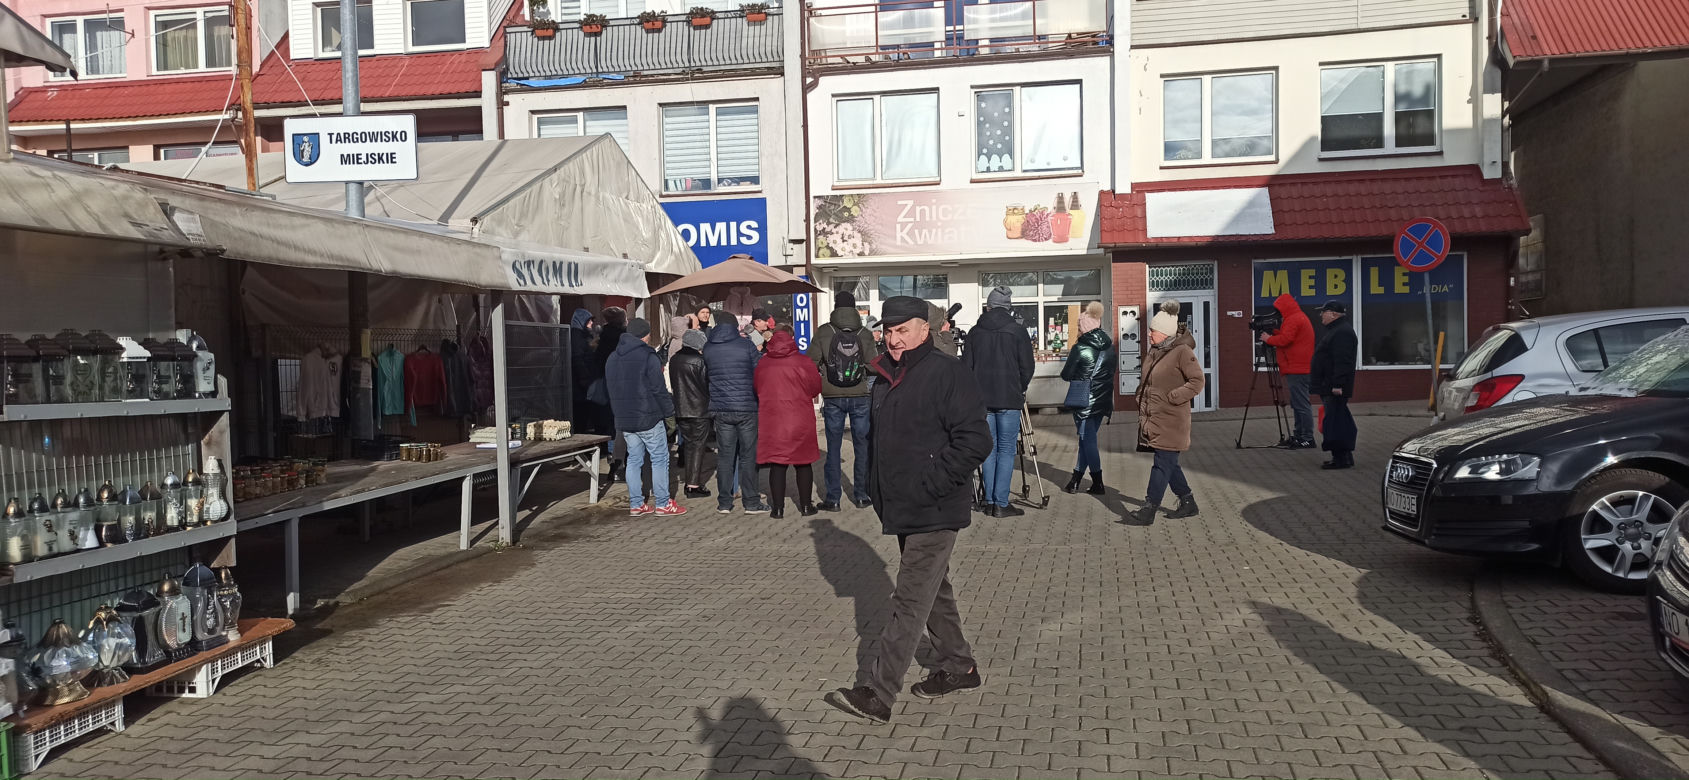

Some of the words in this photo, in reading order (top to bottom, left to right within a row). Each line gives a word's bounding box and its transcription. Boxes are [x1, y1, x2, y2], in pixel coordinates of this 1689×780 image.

[328, 130, 408, 144] TARGOWISKO
[340, 152, 397, 165] MIEJSKIE
[1260, 267, 1410, 297] MEBLE
